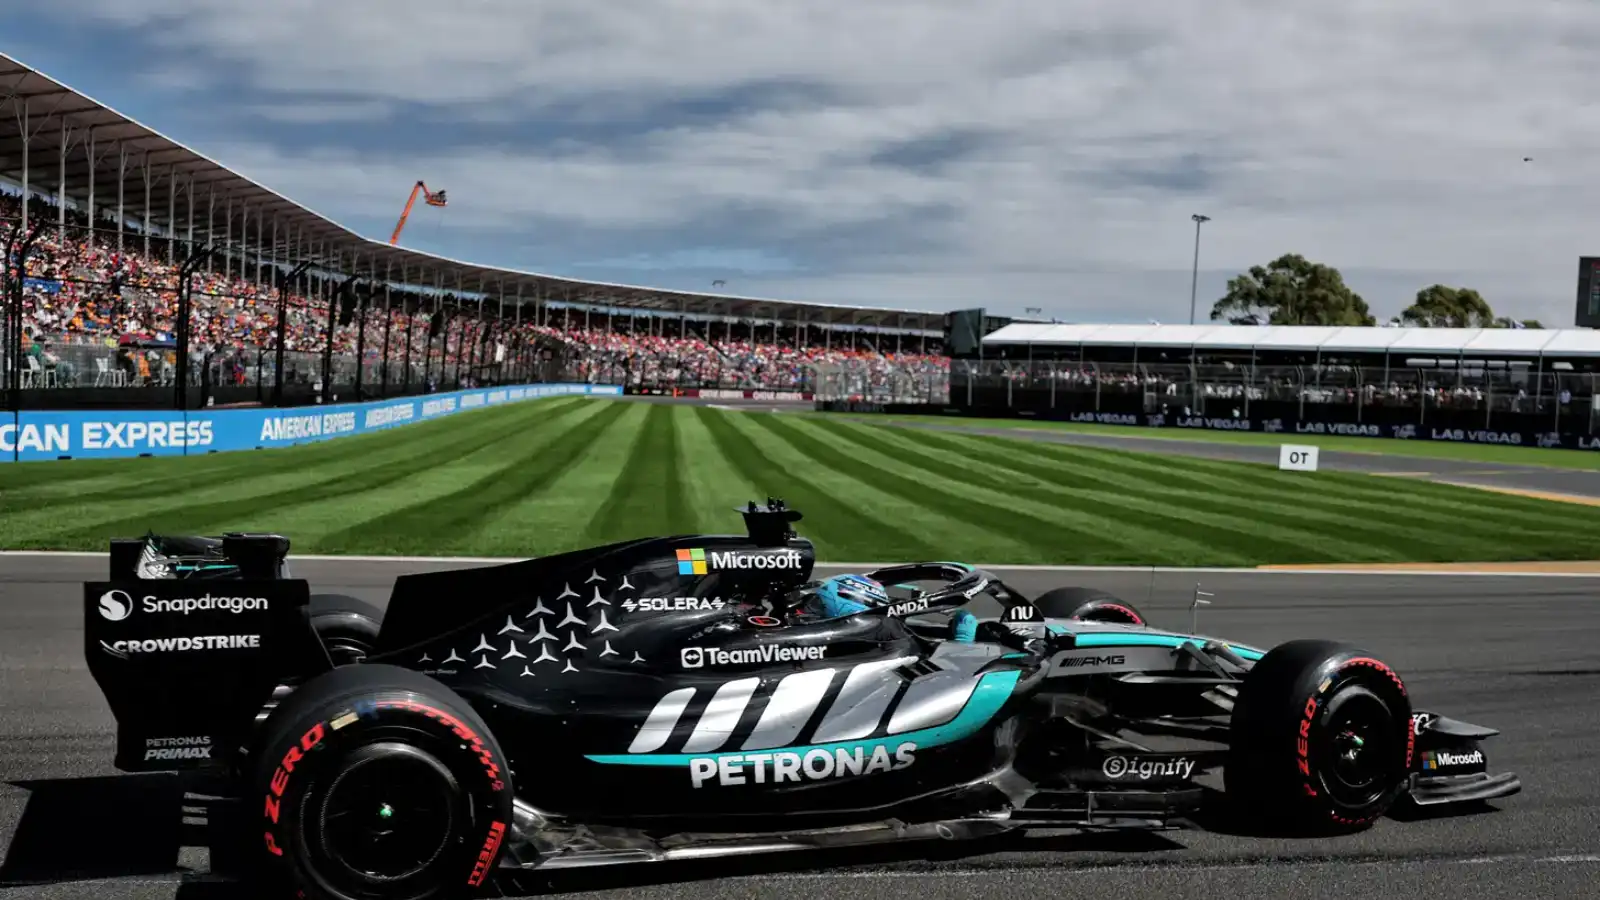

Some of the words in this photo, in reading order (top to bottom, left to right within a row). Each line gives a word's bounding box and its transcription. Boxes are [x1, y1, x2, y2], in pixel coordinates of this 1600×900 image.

[1070, 412, 1093, 422] LAS
[1095, 413, 1137, 424] VEGAS
[1177, 416, 1202, 427] LAS
[1204, 417, 1250, 430] VEGAS
[261, 414, 322, 441] AMERICAN
[323, 412, 355, 434] EXPRESS
[1296, 422, 1325, 433] LAS
[1327, 423, 1379, 436] VEGAS
[82, 421, 213, 449] EXPRESS
[1431, 428, 1464, 439] LAS
[1468, 430, 1521, 443] VEGAS
[1289, 452, 1309, 465] OT
[711, 550, 801, 570] Microsoft
[143, 593, 268, 615] Snapdragon
[638, 598, 713, 611] SOLERA
[887, 602, 917, 618] AMD
[112, 635, 260, 653] CROWDSTRIKE
[704, 644, 827, 665] TeamViewer
[1080, 655, 1125, 666] AMG
[146, 736, 211, 747] PETRONAS
[144, 746, 213, 760] PRIMAX
[1437, 750, 1483, 766] Microsoft
[689, 741, 917, 788] PETRONAS
[264, 723, 325, 824] ZERO
